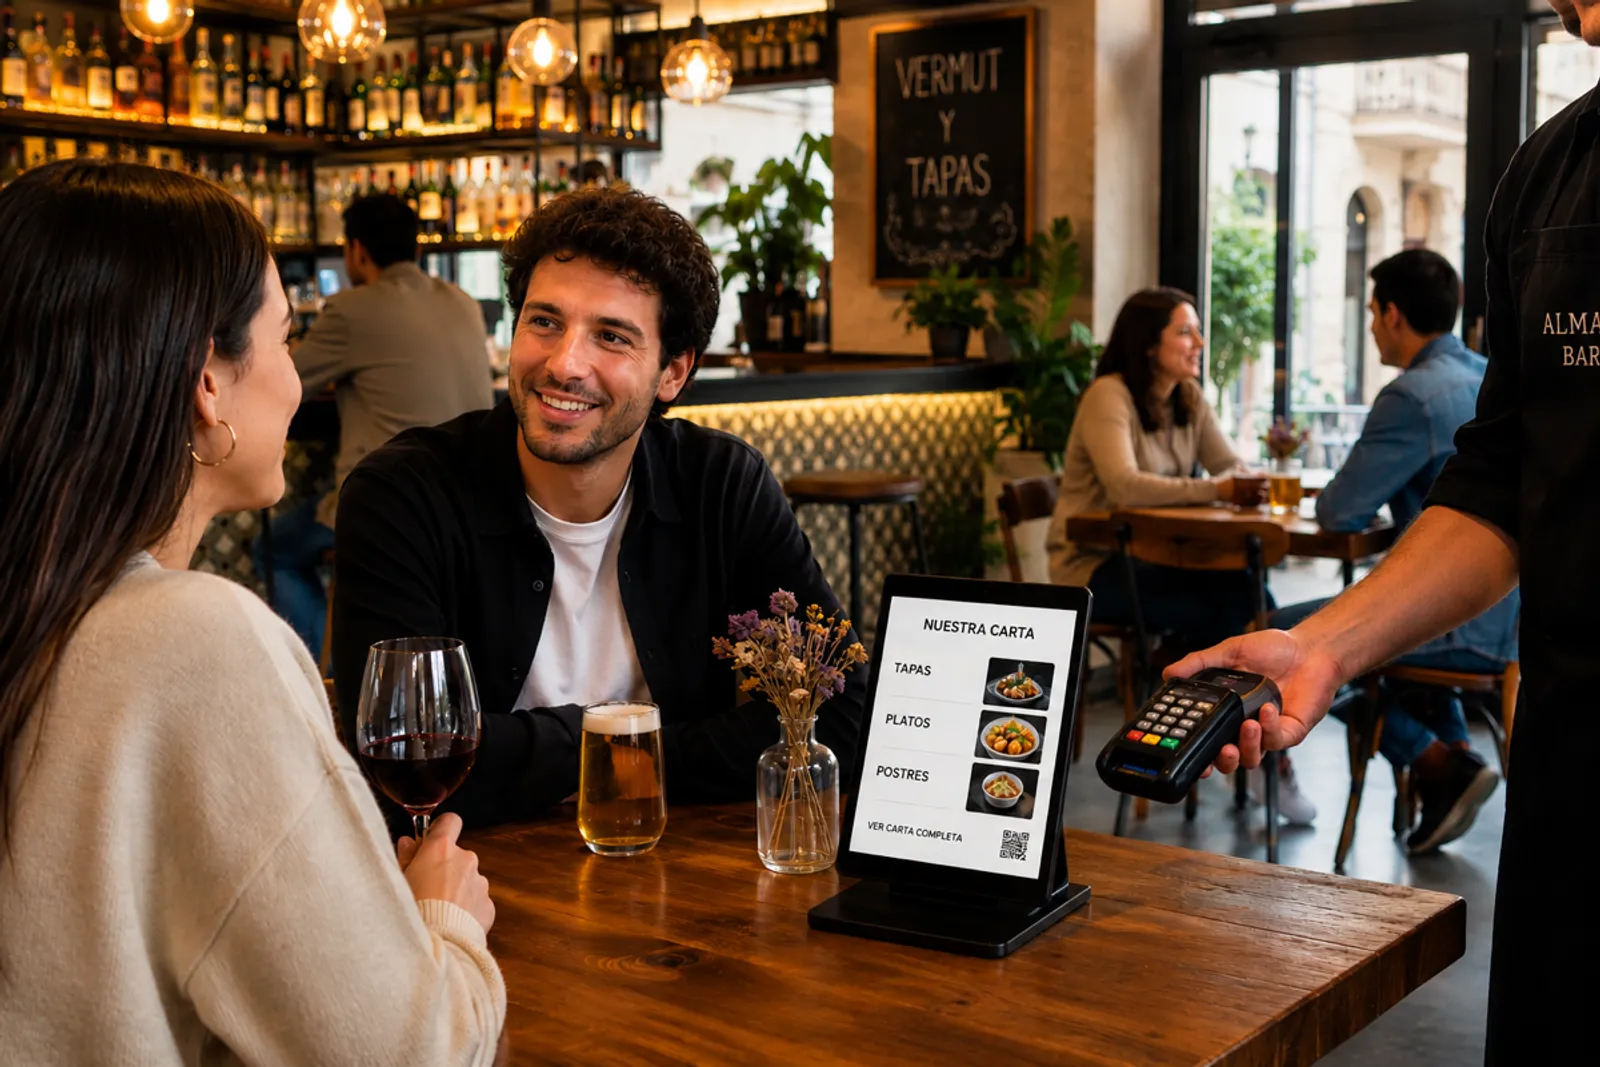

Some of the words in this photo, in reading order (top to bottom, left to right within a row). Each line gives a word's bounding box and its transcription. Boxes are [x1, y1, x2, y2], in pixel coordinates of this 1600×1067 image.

[895, 48, 1002, 98] VERMUT
[938, 109, 956, 142] Y
[905, 153, 992, 197] TAPAS
[1543, 311, 1600, 335] ALMA
[1562, 345, 1600, 366] BAR
[923, 618, 987, 636] NUESTRA
[989, 624, 1035, 640] CARTA
[894, 662, 932, 676] TAPAS
[885, 713, 931, 729] PLATOS
[876, 765, 930, 782] POSTRES
[867, 821, 885, 832] VER
[885, 823, 915, 837] CARTA
[915, 828, 963, 843] COMPLETA
